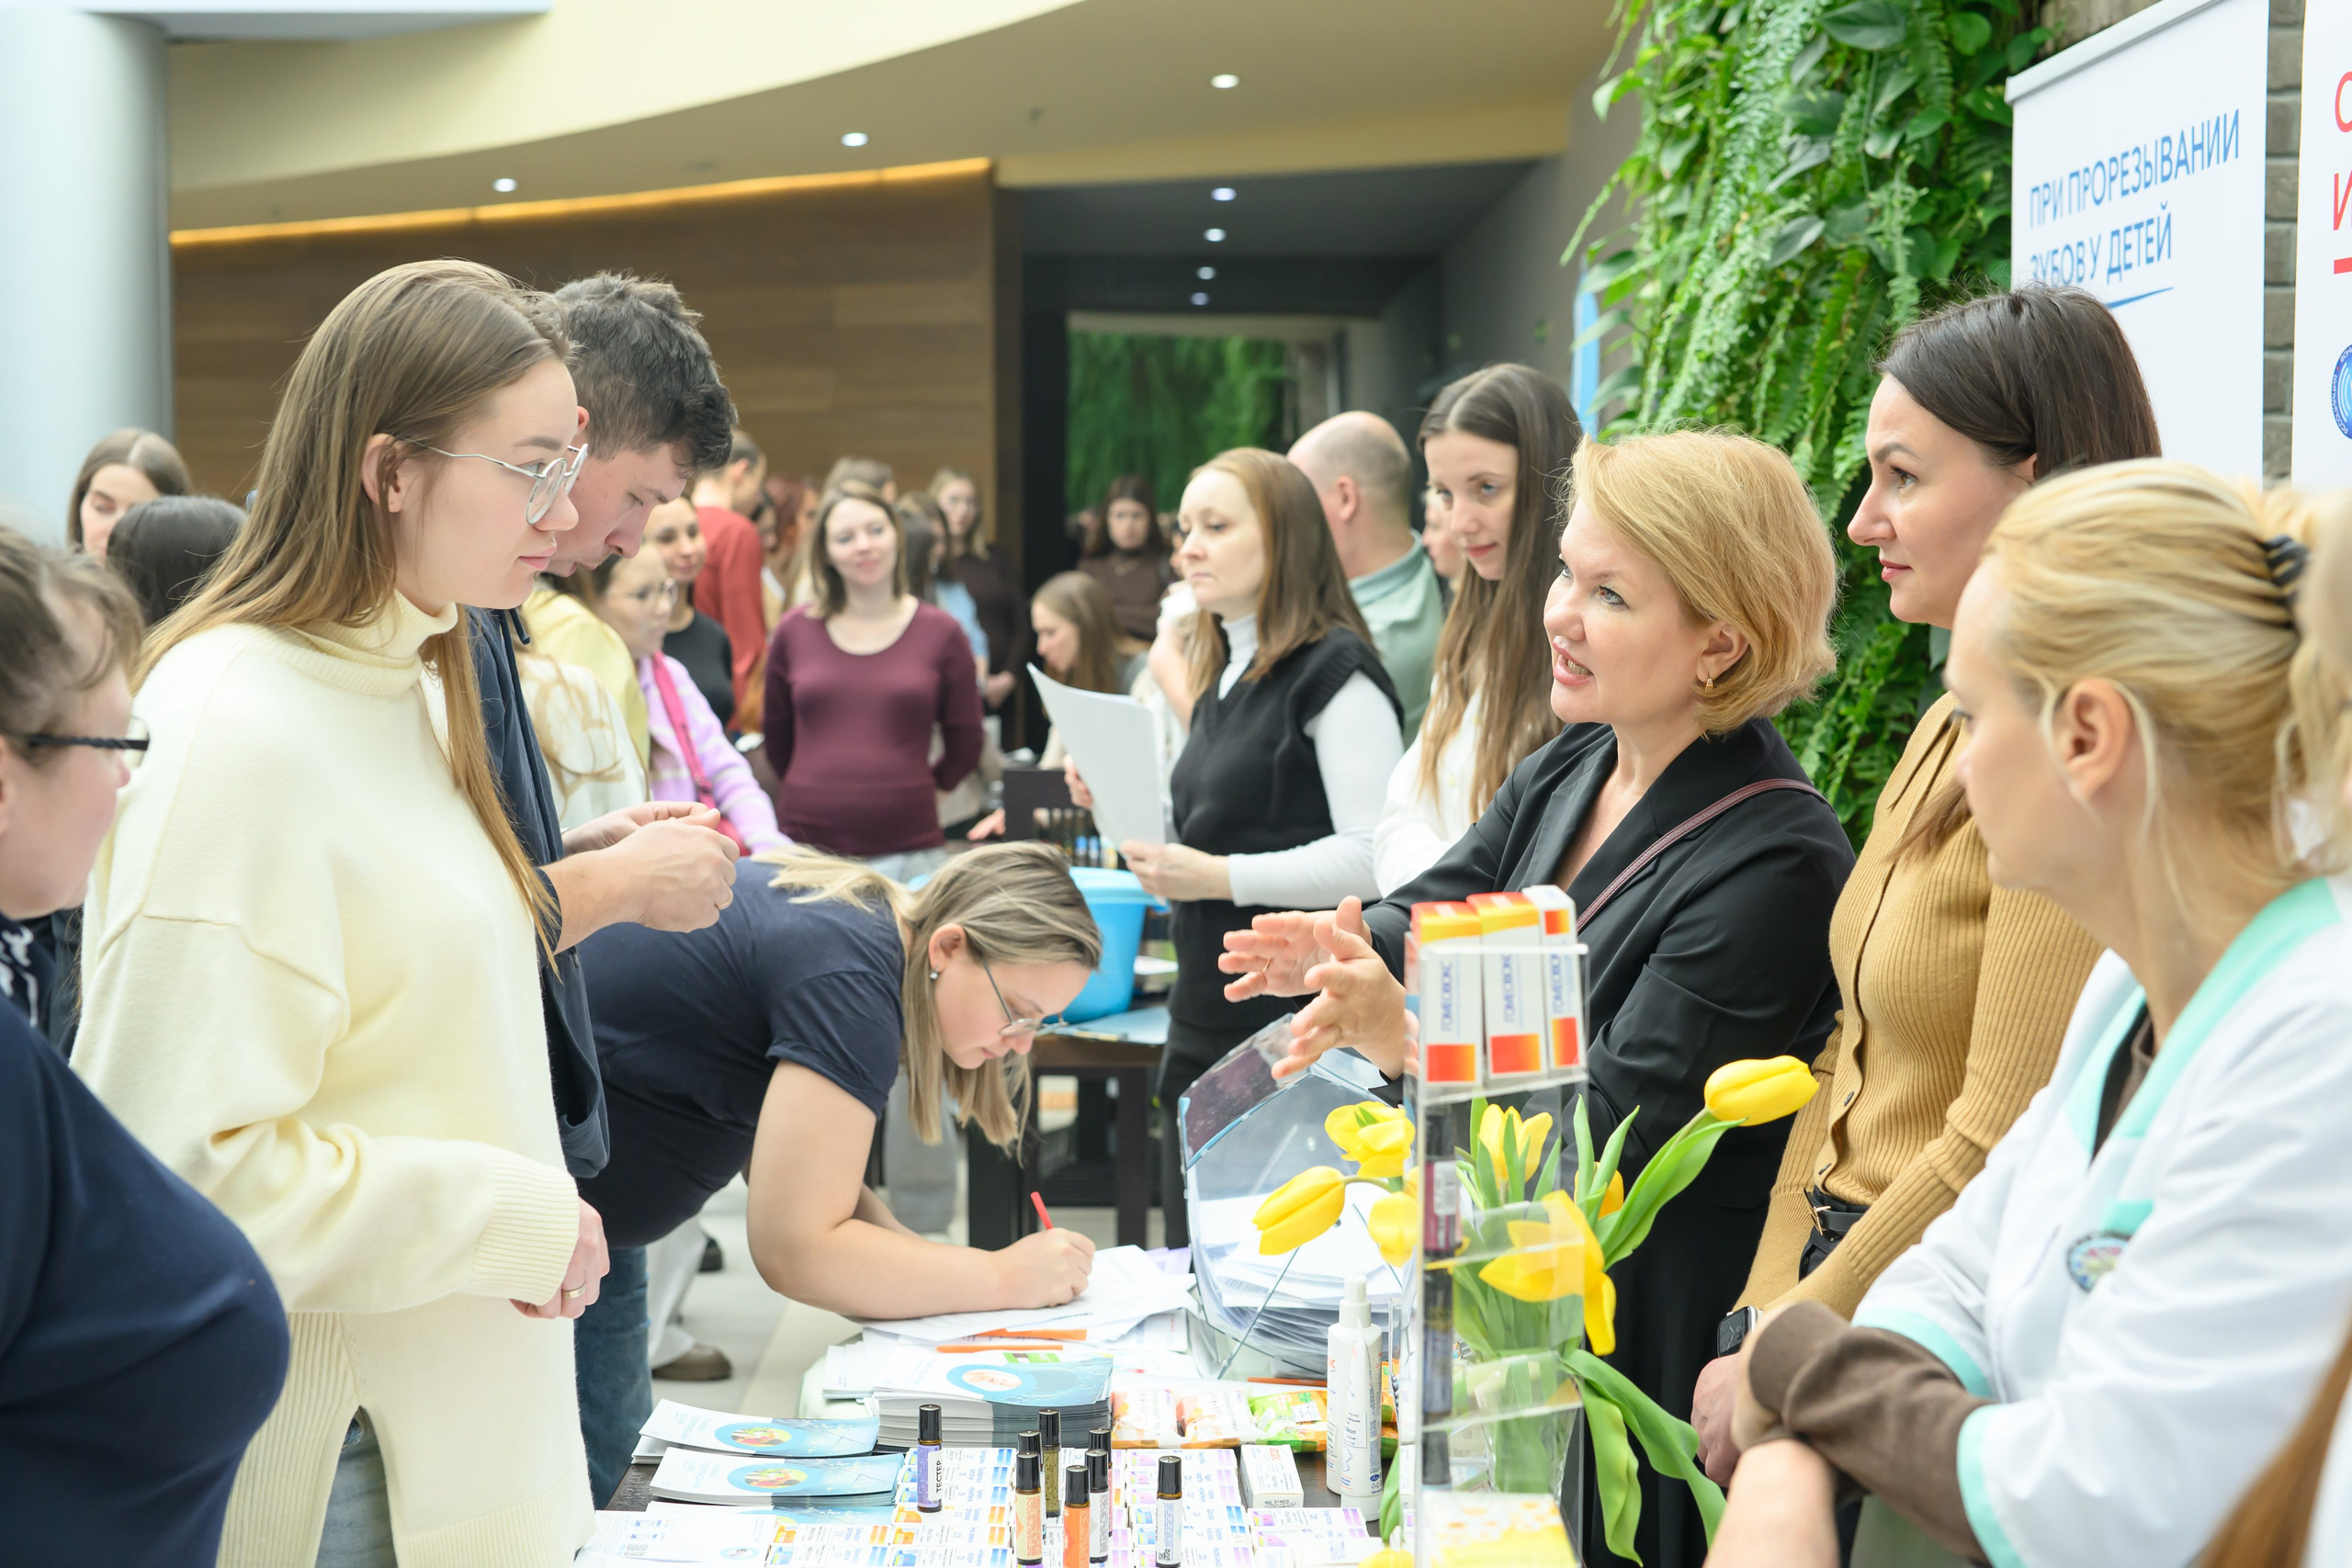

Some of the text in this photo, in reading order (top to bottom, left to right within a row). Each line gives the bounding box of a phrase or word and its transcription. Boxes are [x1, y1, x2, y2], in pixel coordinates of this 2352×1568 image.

[2030, 108, 2239, 229] ПРИ ПРОРЕЗЫВАНИИ
[2030, 200, 2172, 287] ЗУБОВ У ДЕТЕЙ
